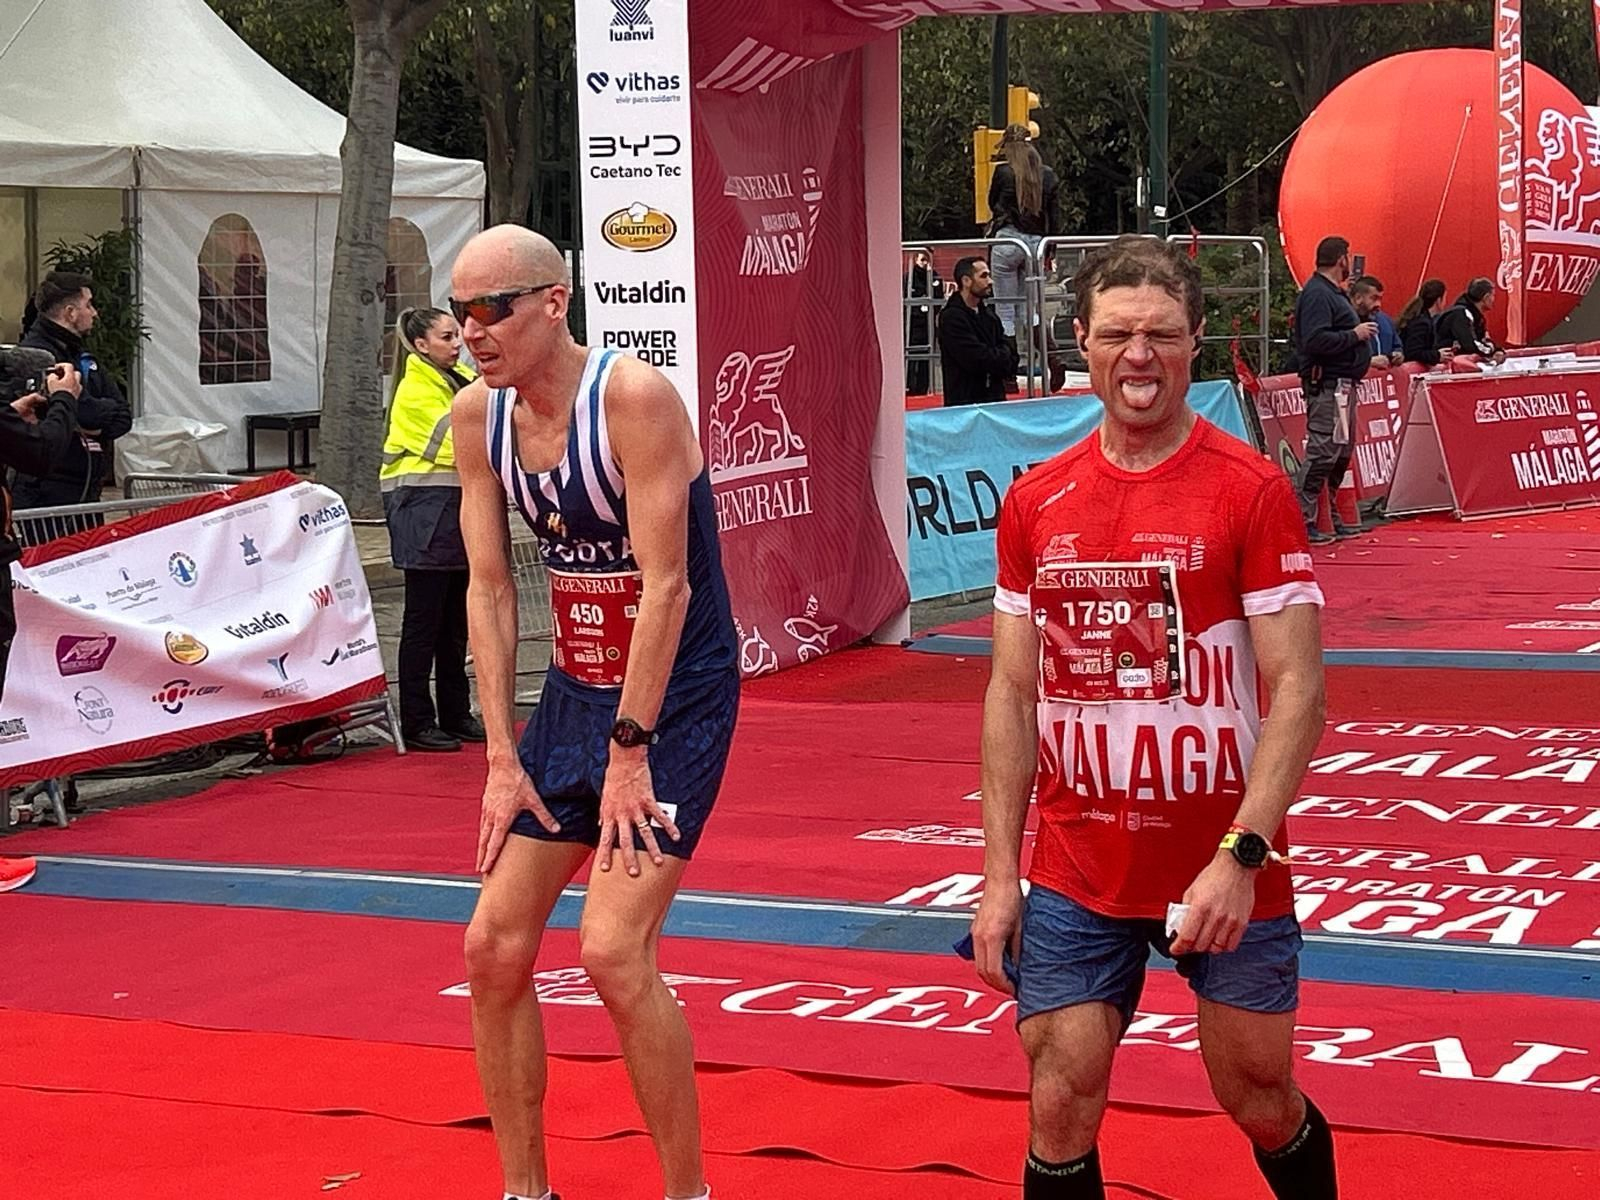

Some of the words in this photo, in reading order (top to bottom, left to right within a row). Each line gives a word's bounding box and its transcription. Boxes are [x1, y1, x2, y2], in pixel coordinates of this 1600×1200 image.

[609, 27, 654, 42] luanvi
[615, 72, 680, 91] vithas
[589, 135, 681, 158] BYD
[590, 165, 653, 179] Caetano
[656, 164, 681, 177] Tec
[609, 223, 668, 236] Gourmet
[594, 280, 685, 304] Vitaldin
[603, 330, 677, 348] POWER
[1498, 393, 1571, 421] GENERALI
[1511, 443, 1590, 490] MÁLAGA
[907, 469, 1001, 540] RLD
[559, 578, 626, 594] GENERALI
[1061, 569, 1150, 588] GENERALI
[569, 603, 604, 626] 450
[804, 594, 819, 619] 42K
[1062, 600, 1131, 627] 1750
[223, 611, 291, 641] Vitaldin
[1335, 722, 1600, 741] GENE
